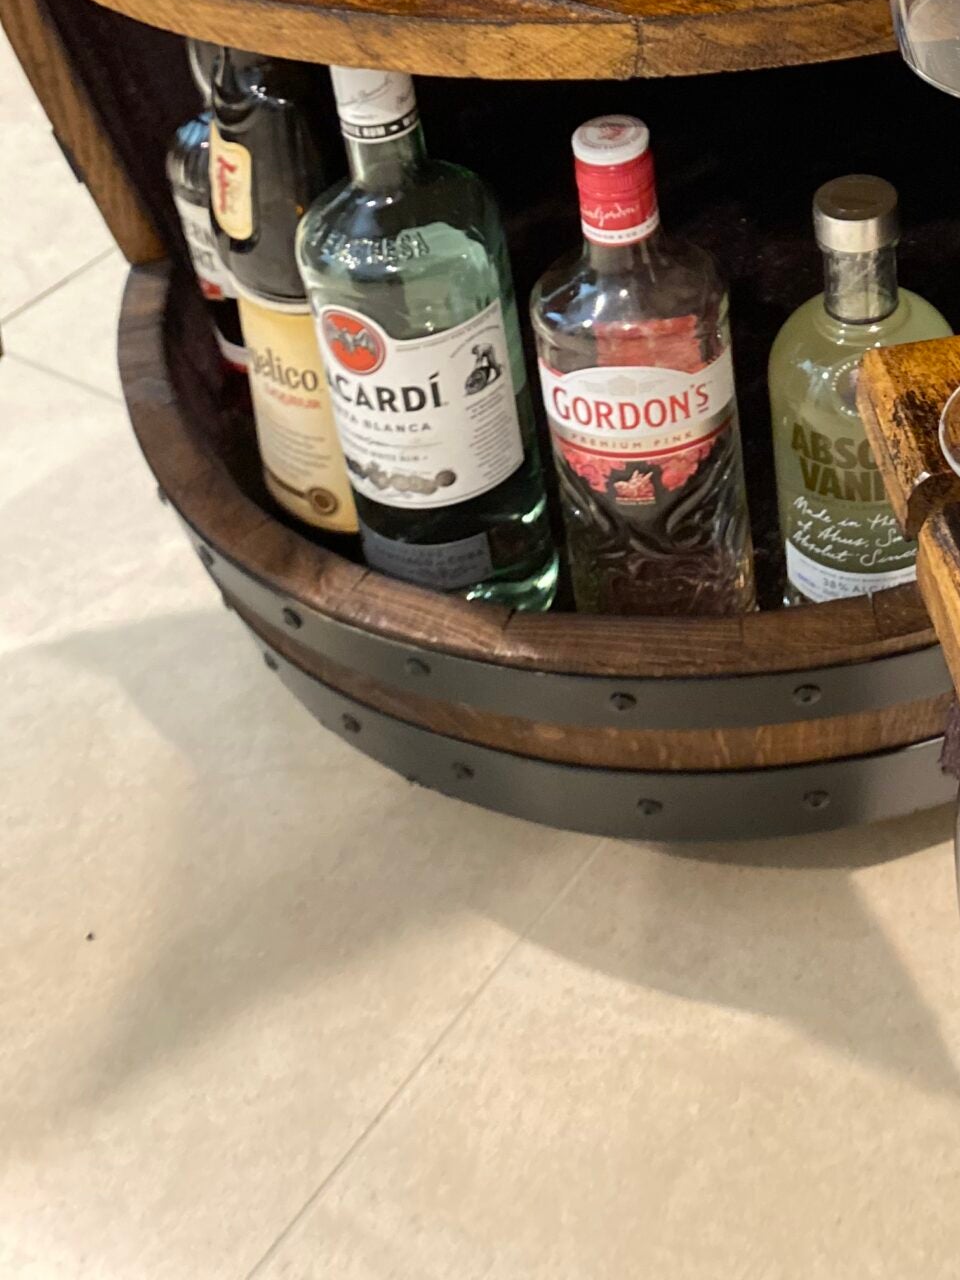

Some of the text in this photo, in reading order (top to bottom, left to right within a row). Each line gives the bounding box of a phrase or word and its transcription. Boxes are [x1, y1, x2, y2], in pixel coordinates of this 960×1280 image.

[552, 382, 709, 431] GORDON'S
[363, 419, 432, 433] BLANCA
[571, 431, 694, 450] PREMIUM PINK
